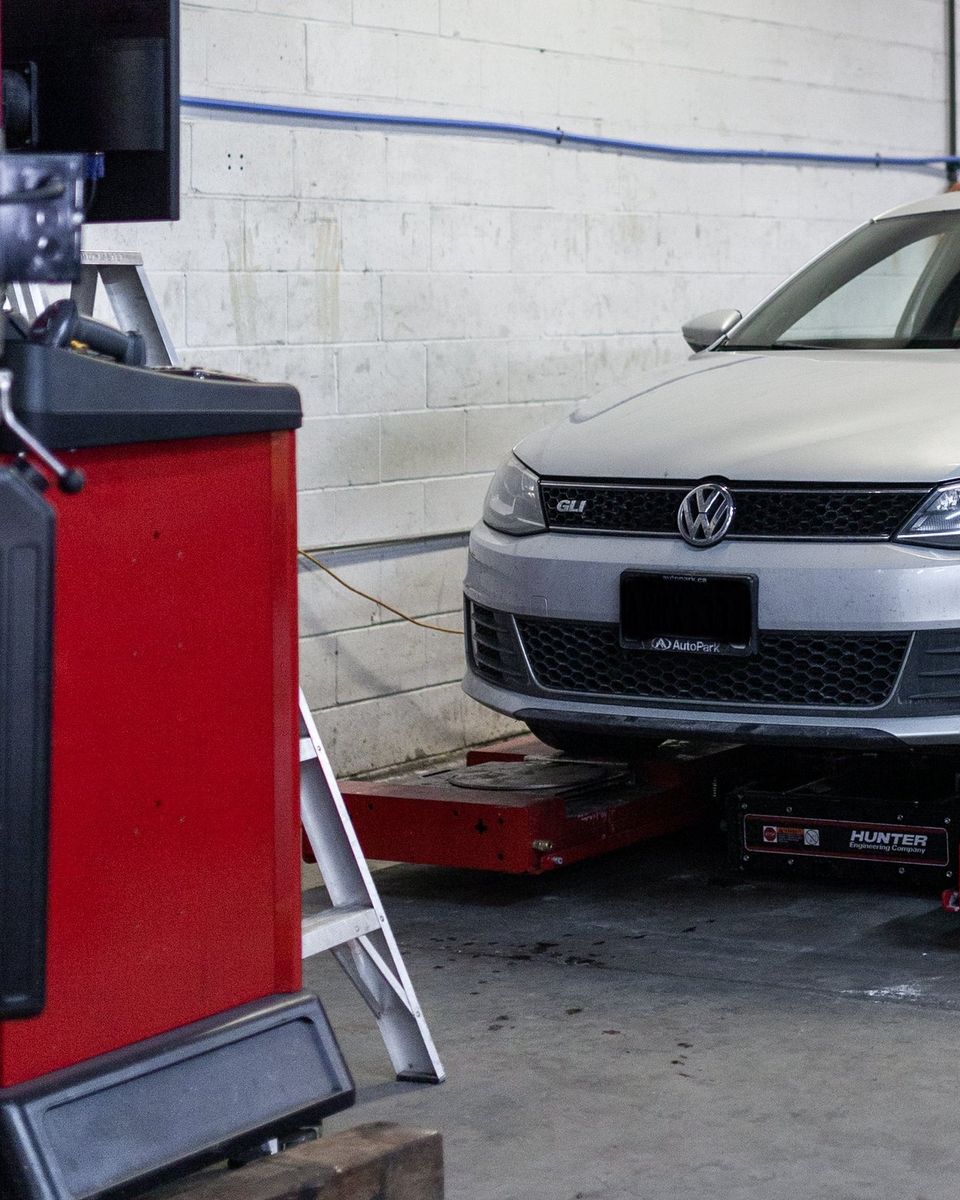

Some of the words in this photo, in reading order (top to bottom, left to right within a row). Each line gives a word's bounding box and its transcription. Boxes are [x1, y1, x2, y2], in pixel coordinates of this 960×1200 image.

[556, 499, 587, 513] GLI
[672, 639, 721, 653] AutoPark
[850, 830, 928, 847] HUNTER
[849, 841, 891, 852] Engineering
[891, 844, 926, 854] Company
